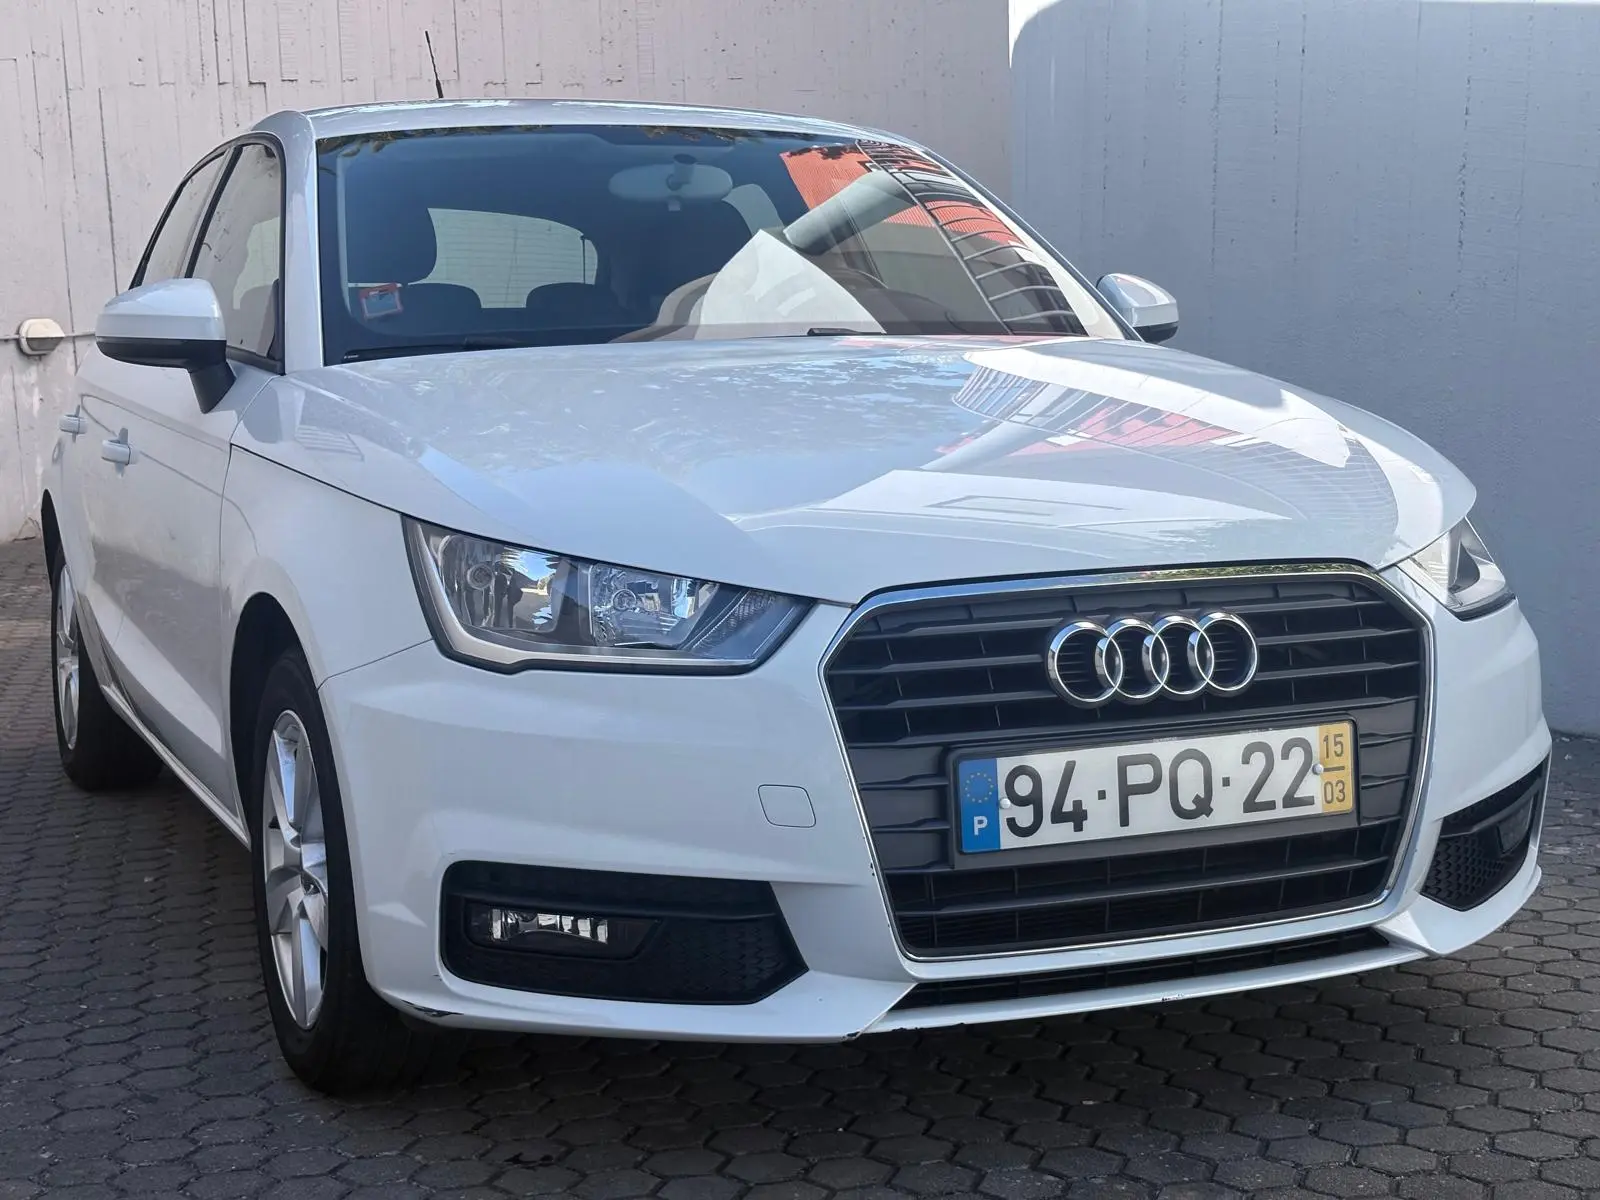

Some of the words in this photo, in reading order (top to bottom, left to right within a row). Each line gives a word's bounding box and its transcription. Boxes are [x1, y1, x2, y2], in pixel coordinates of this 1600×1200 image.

[1323, 733, 1344, 759] 15
[1323, 779, 1346, 804] 03
[973, 815, 988, 836] P
